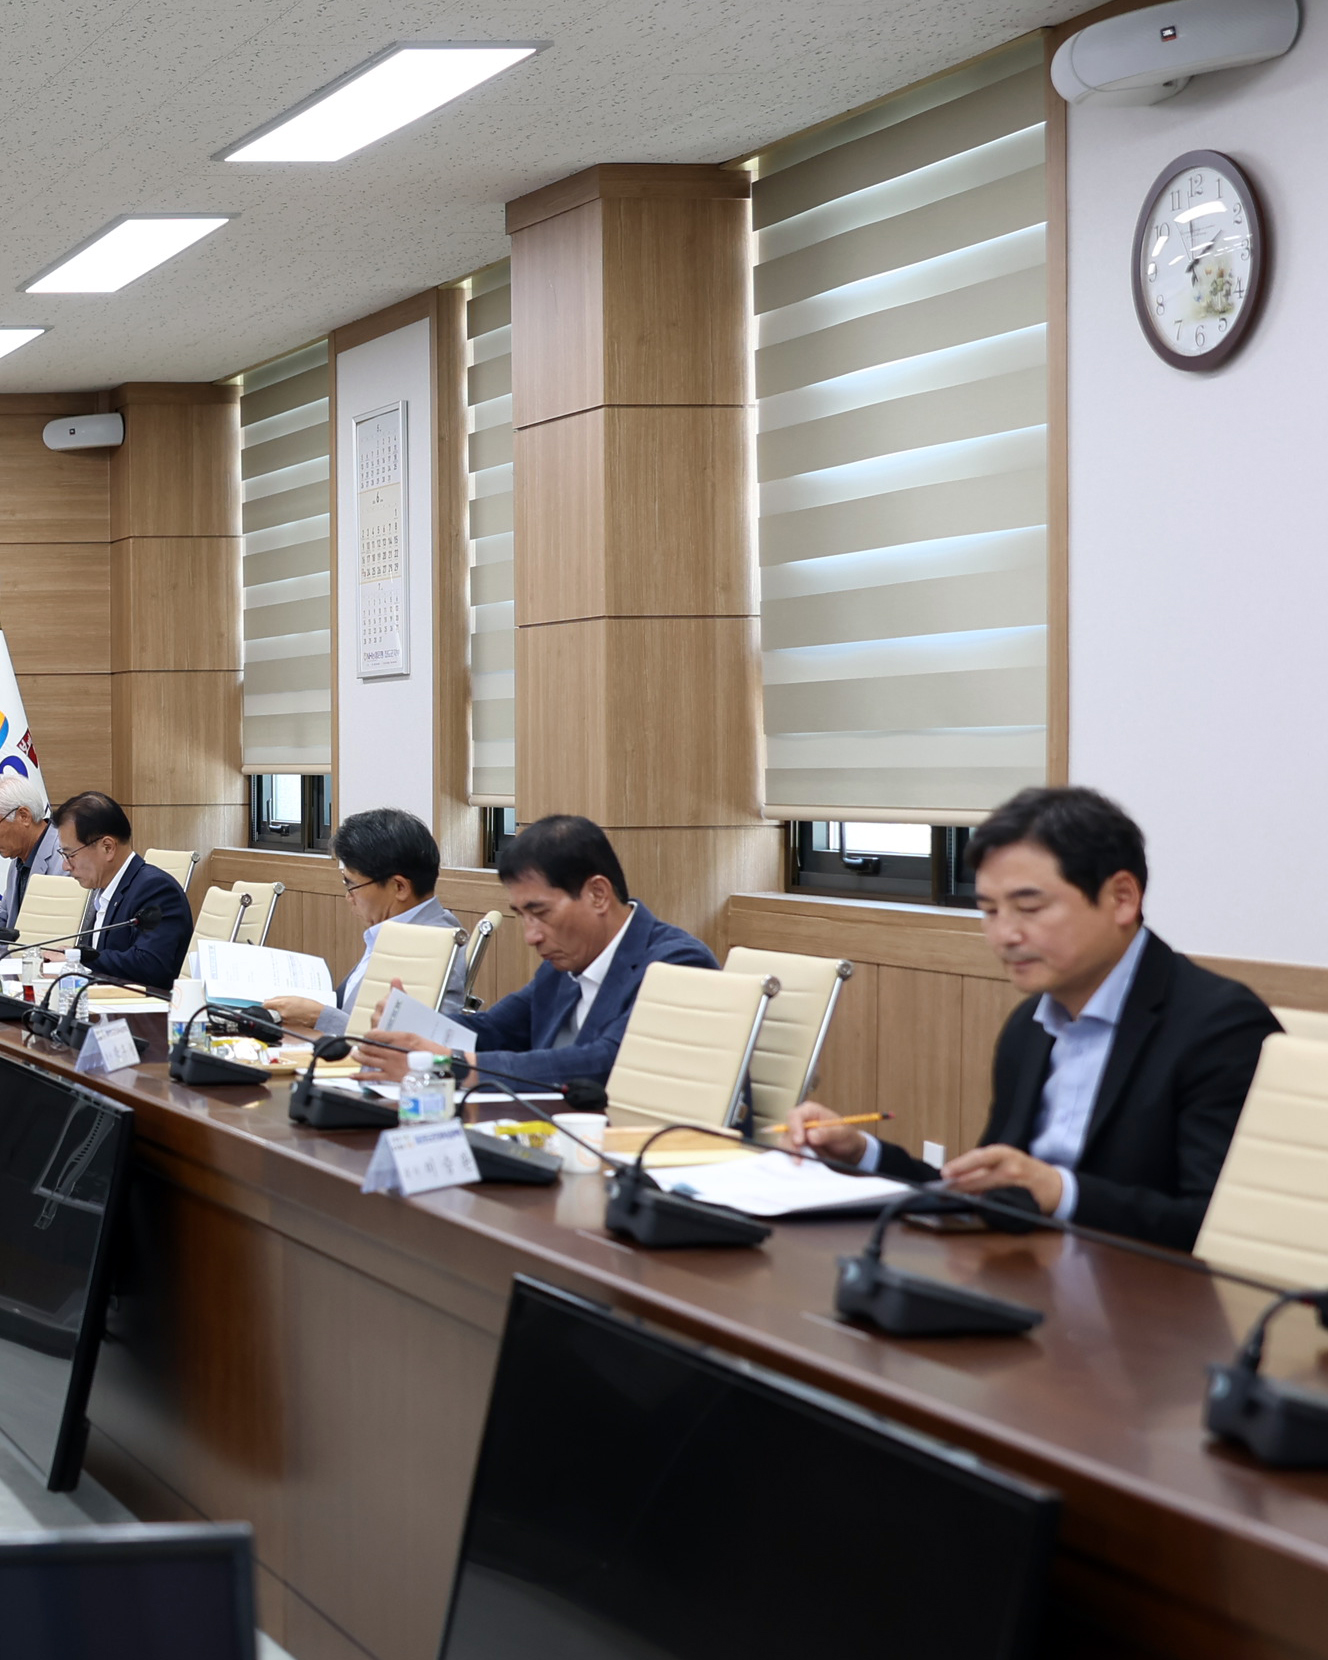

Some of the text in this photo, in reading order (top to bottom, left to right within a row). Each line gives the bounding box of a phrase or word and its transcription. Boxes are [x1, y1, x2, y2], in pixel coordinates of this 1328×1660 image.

[1189, 174, 1203, 197] 12
[1216, 178, 1223, 198] 1
[1170, 190, 1181, 211] 11
[1233, 203, 1242, 224] 2
[1241, 238, 1250, 260] 3
[1234, 277, 1244, 299] 4
[1156, 294, 1165, 316] 8
[1174, 319, 1183, 341] 7
[1218, 317, 1227, 332] 5
[1195, 325, 1205, 347] 6
